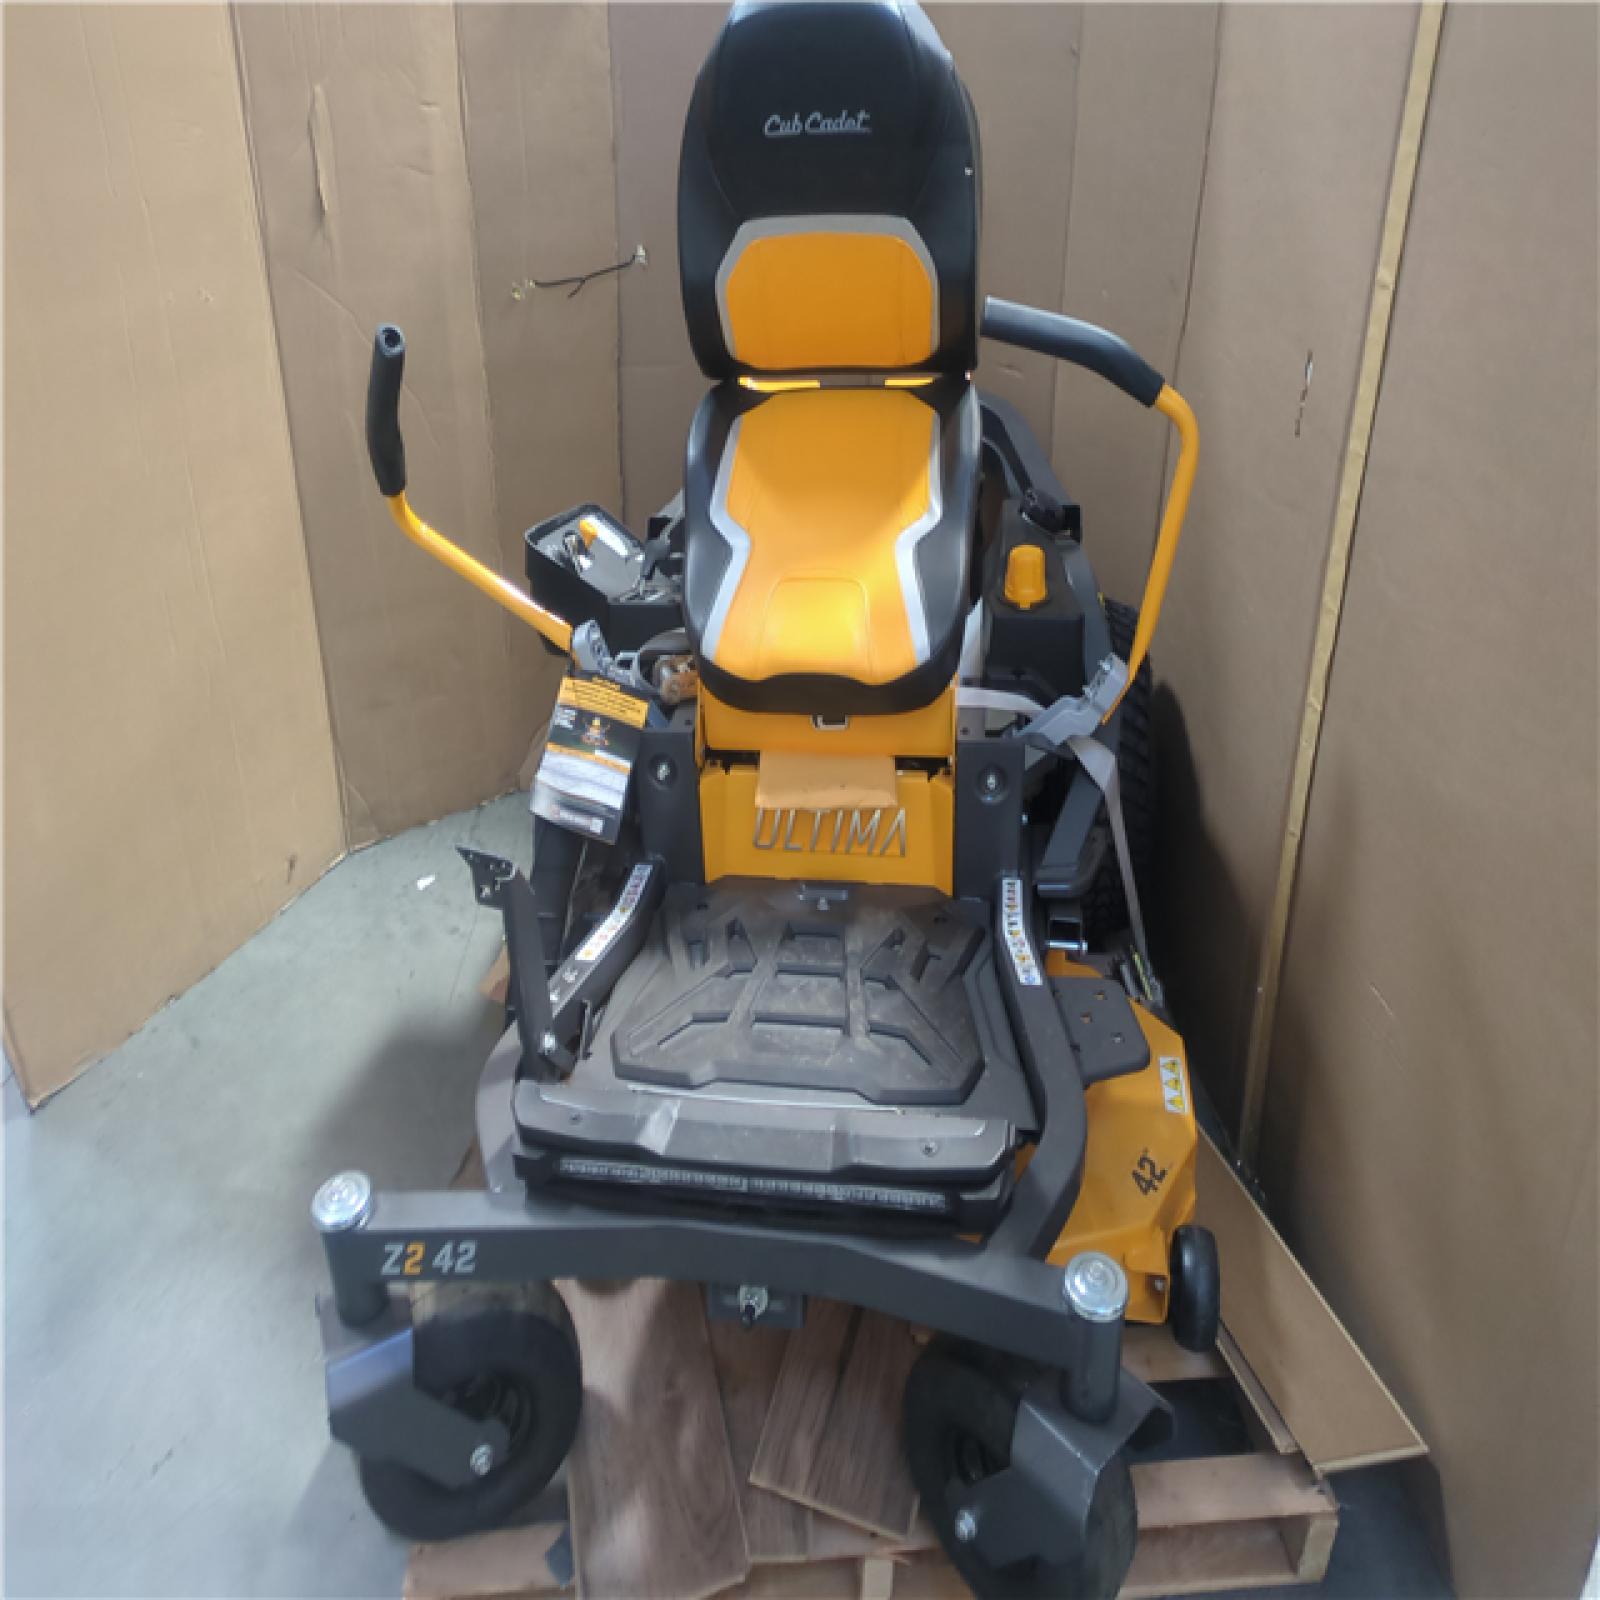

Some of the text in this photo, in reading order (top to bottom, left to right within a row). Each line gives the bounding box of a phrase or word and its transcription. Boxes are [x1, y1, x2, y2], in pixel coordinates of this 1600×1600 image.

[764, 109, 872, 136] Cub Cadet
[753, 808, 906, 857] ULTIMA
[432, 1240, 476, 1274] 42
